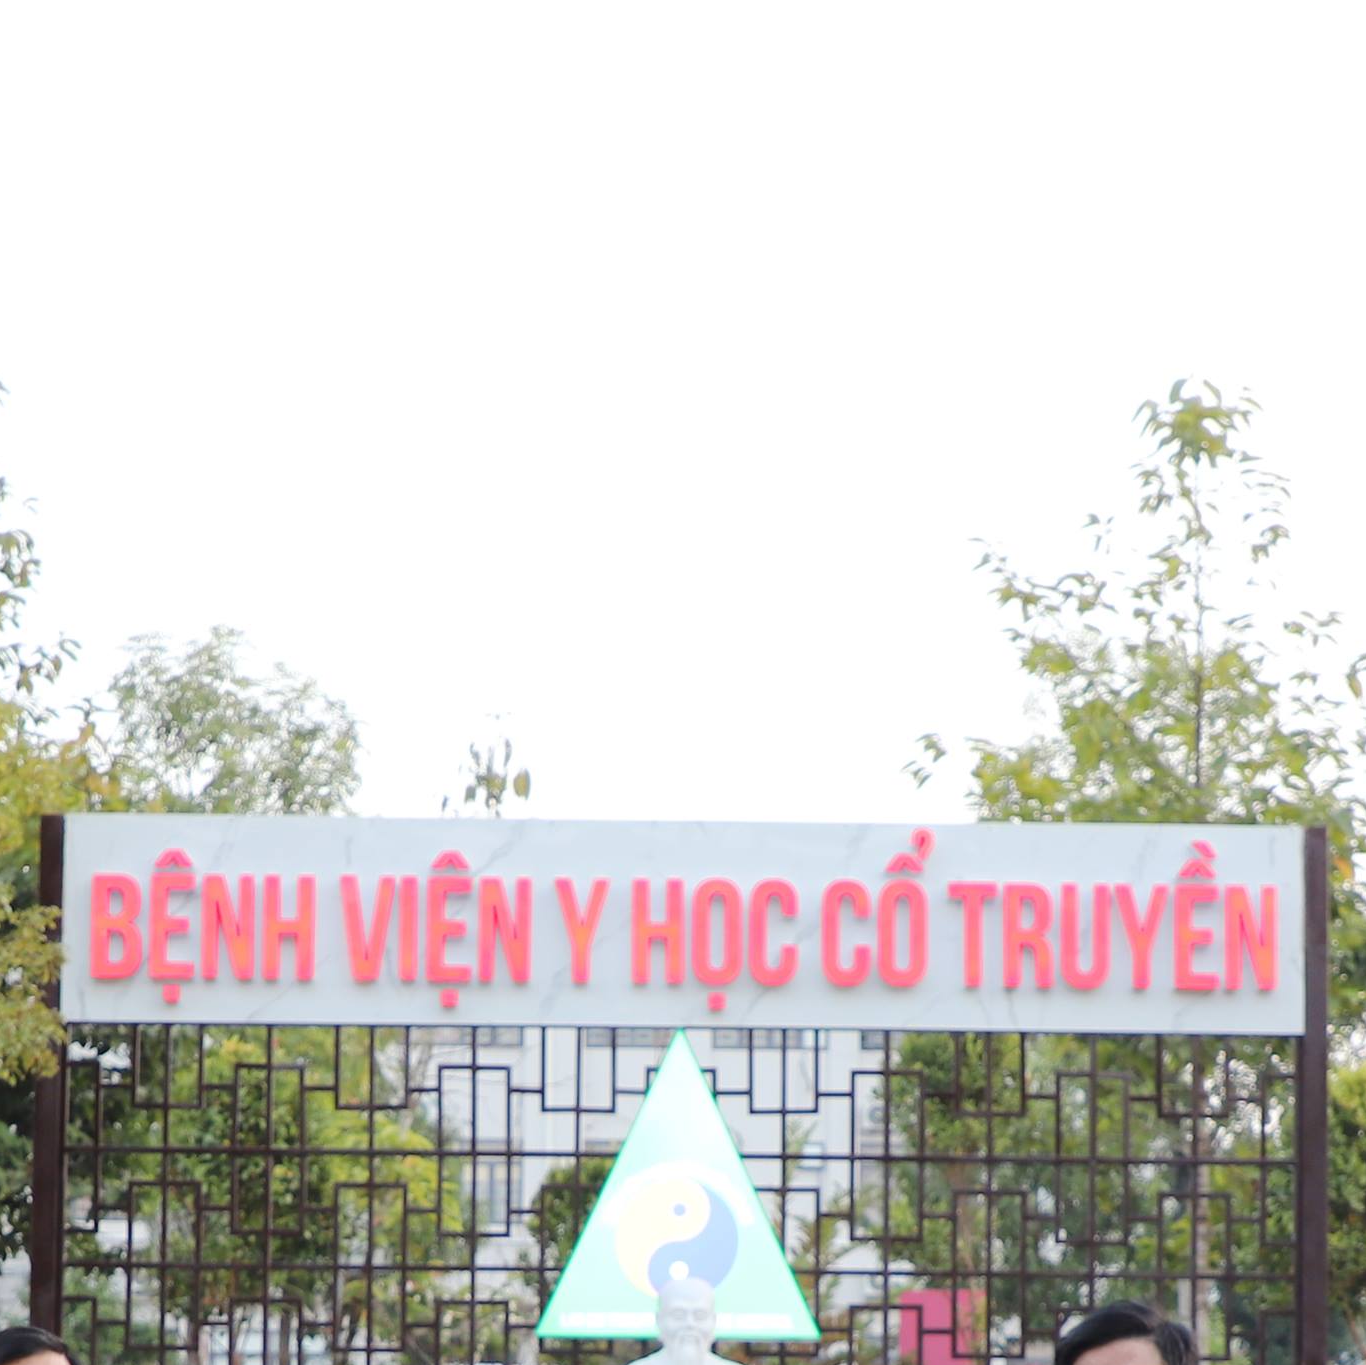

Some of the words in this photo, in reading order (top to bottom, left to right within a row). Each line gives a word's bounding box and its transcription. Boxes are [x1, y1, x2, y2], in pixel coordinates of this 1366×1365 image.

[89, 847, 317, 1005] BỆNH
[339, 849, 534, 1009] VIỆN
[554, 876, 611, 985] Y
[630, 877, 801, 1013] HỌC
[820, 827, 935, 989] CỔ
[946, 839, 1279, 993] TRUYỀN
